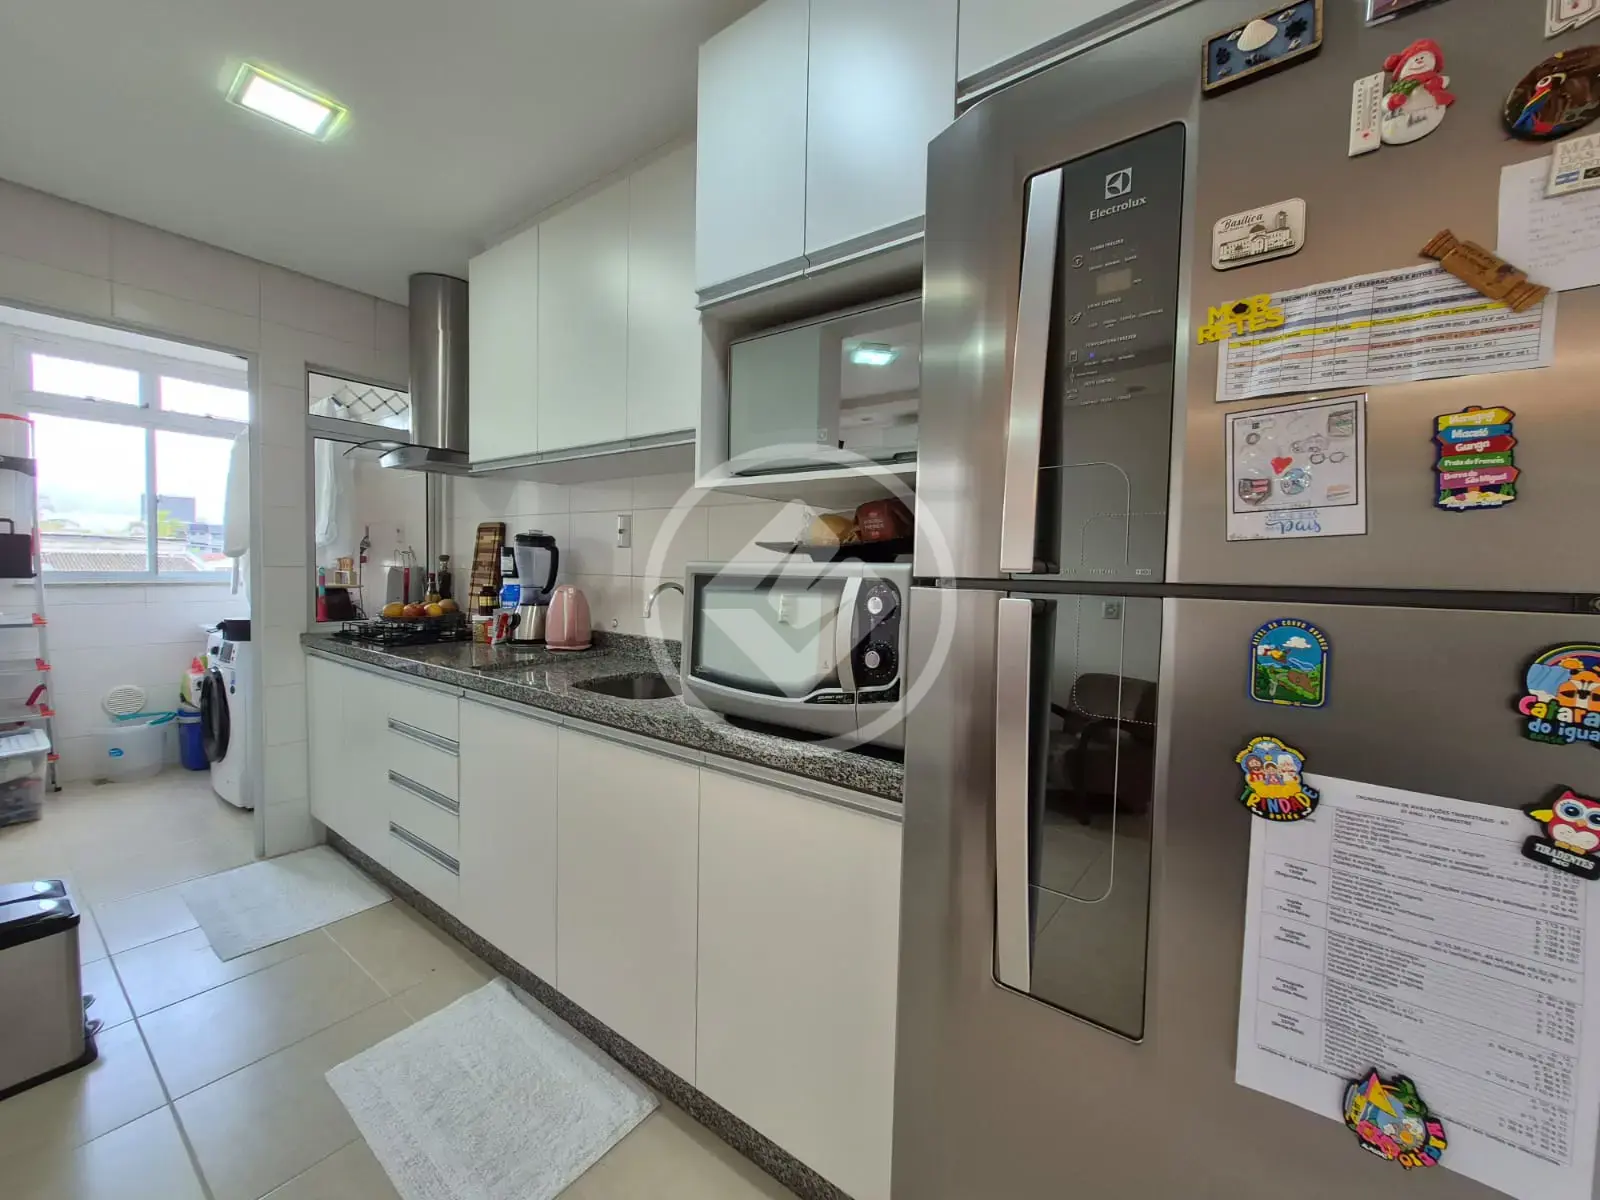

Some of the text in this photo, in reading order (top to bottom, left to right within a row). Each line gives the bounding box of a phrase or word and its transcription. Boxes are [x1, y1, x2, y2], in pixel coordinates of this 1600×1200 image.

[1089, 196, 1147, 221] Electrolux
[1455, 440, 1491, 452] Gunga
[1528, 718, 1552, 733] do
[1240, 785, 1319, 814] TRINDADE
[1535, 842, 1596, 870] TIRADENTES
